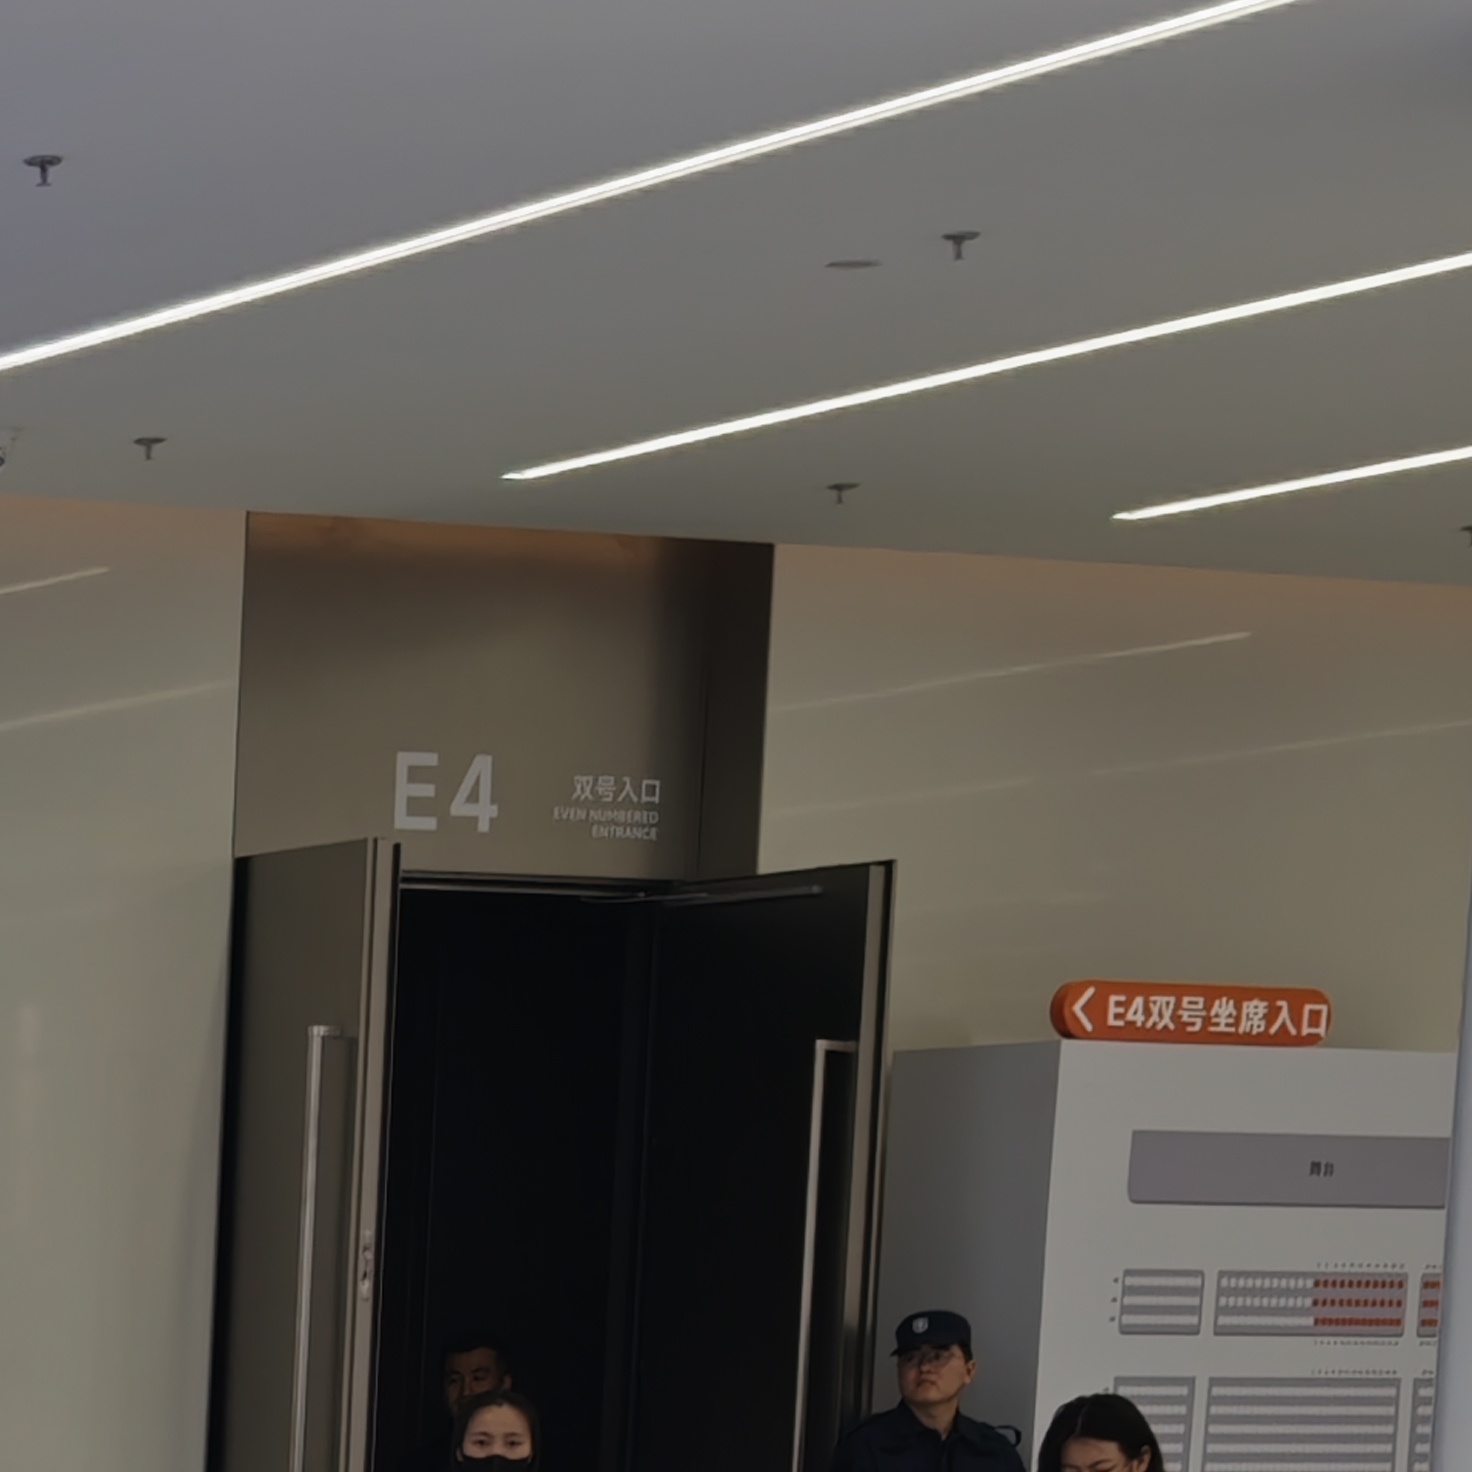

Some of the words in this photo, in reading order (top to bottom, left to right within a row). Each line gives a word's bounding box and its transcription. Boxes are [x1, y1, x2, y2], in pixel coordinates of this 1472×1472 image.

[393, 751, 499, 833] E4
[571, 775, 661, 805] 双号入口
[592, 824, 659, 841] ENTRANCE
[1106, 994, 1329, 1037] E4双号坐席入口
